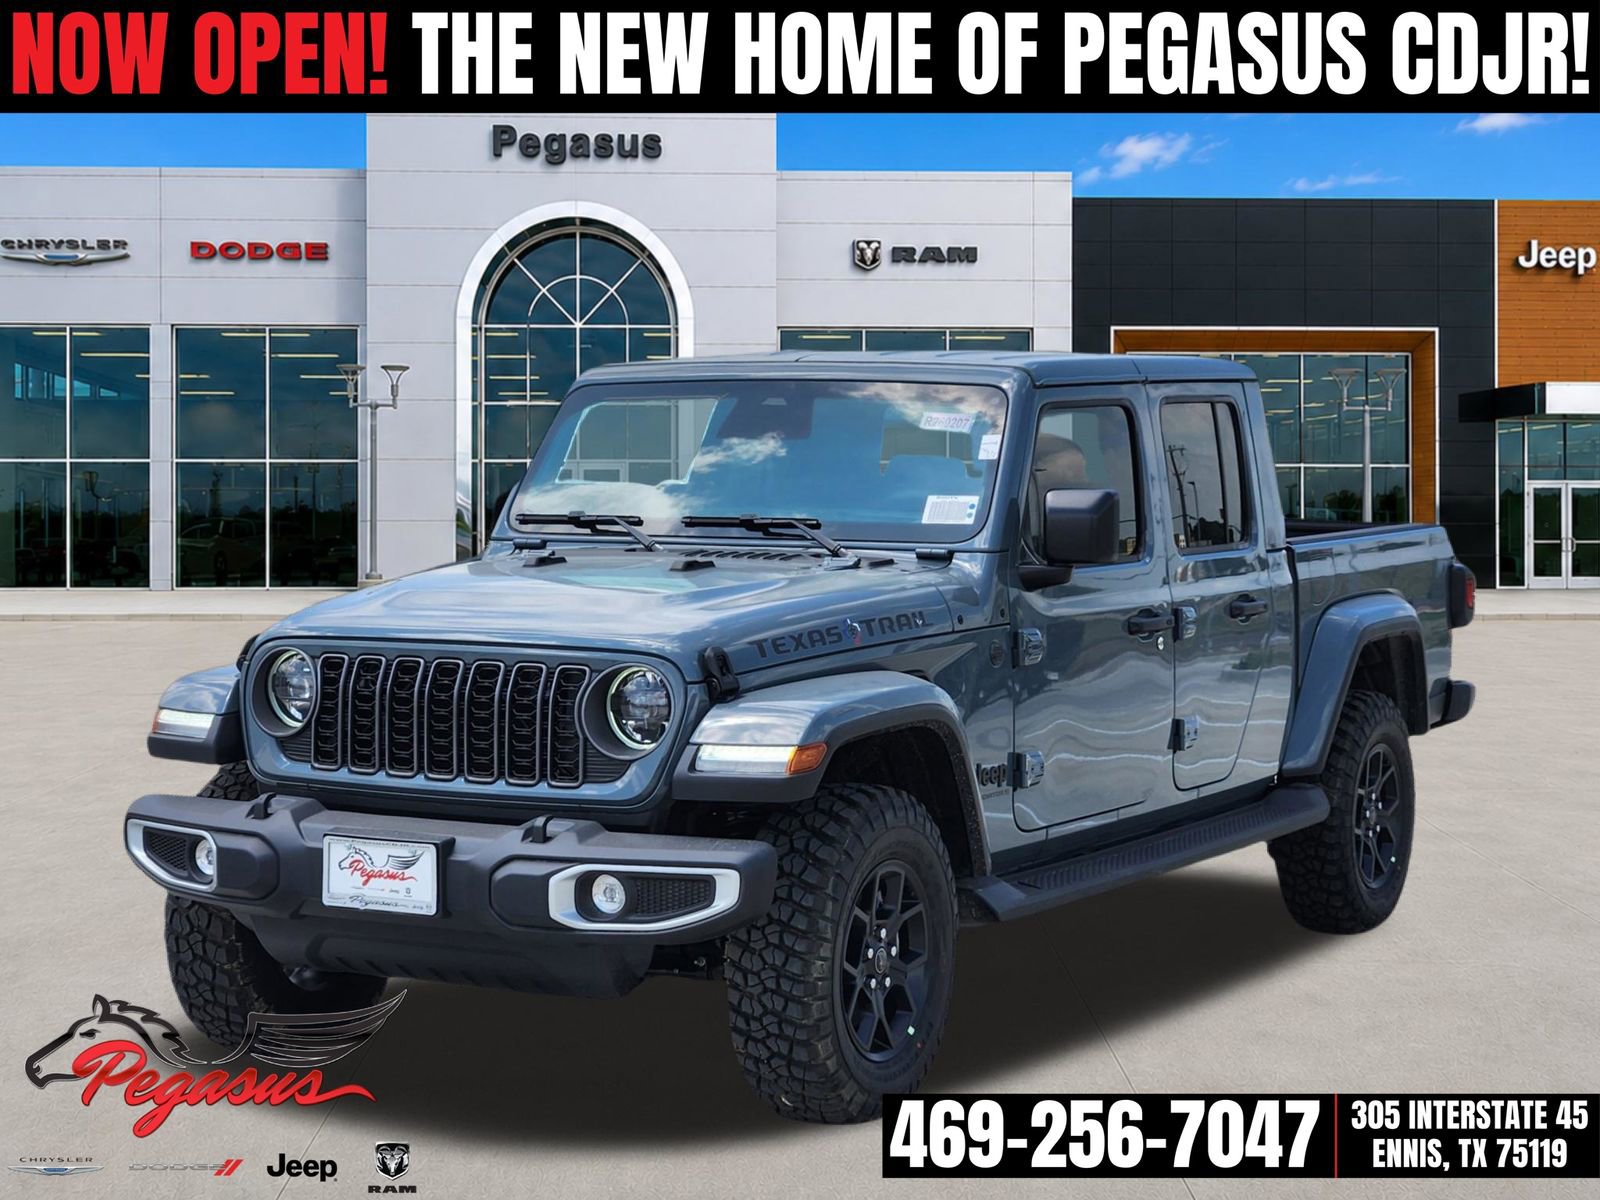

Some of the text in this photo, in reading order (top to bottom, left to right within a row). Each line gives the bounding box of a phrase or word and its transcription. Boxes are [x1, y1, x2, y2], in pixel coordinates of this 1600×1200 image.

[491, 124, 662, 166] Pegasus
[0, 238, 129, 252] CHRYSLER
[189, 241, 330, 261] DODGE
[891, 245, 978, 264] RAM
[1517, 239, 1597, 275] Jeep
[749, 610, 933, 658] TEXAS TRAIL
[348, 859, 417, 886] Pegasus
